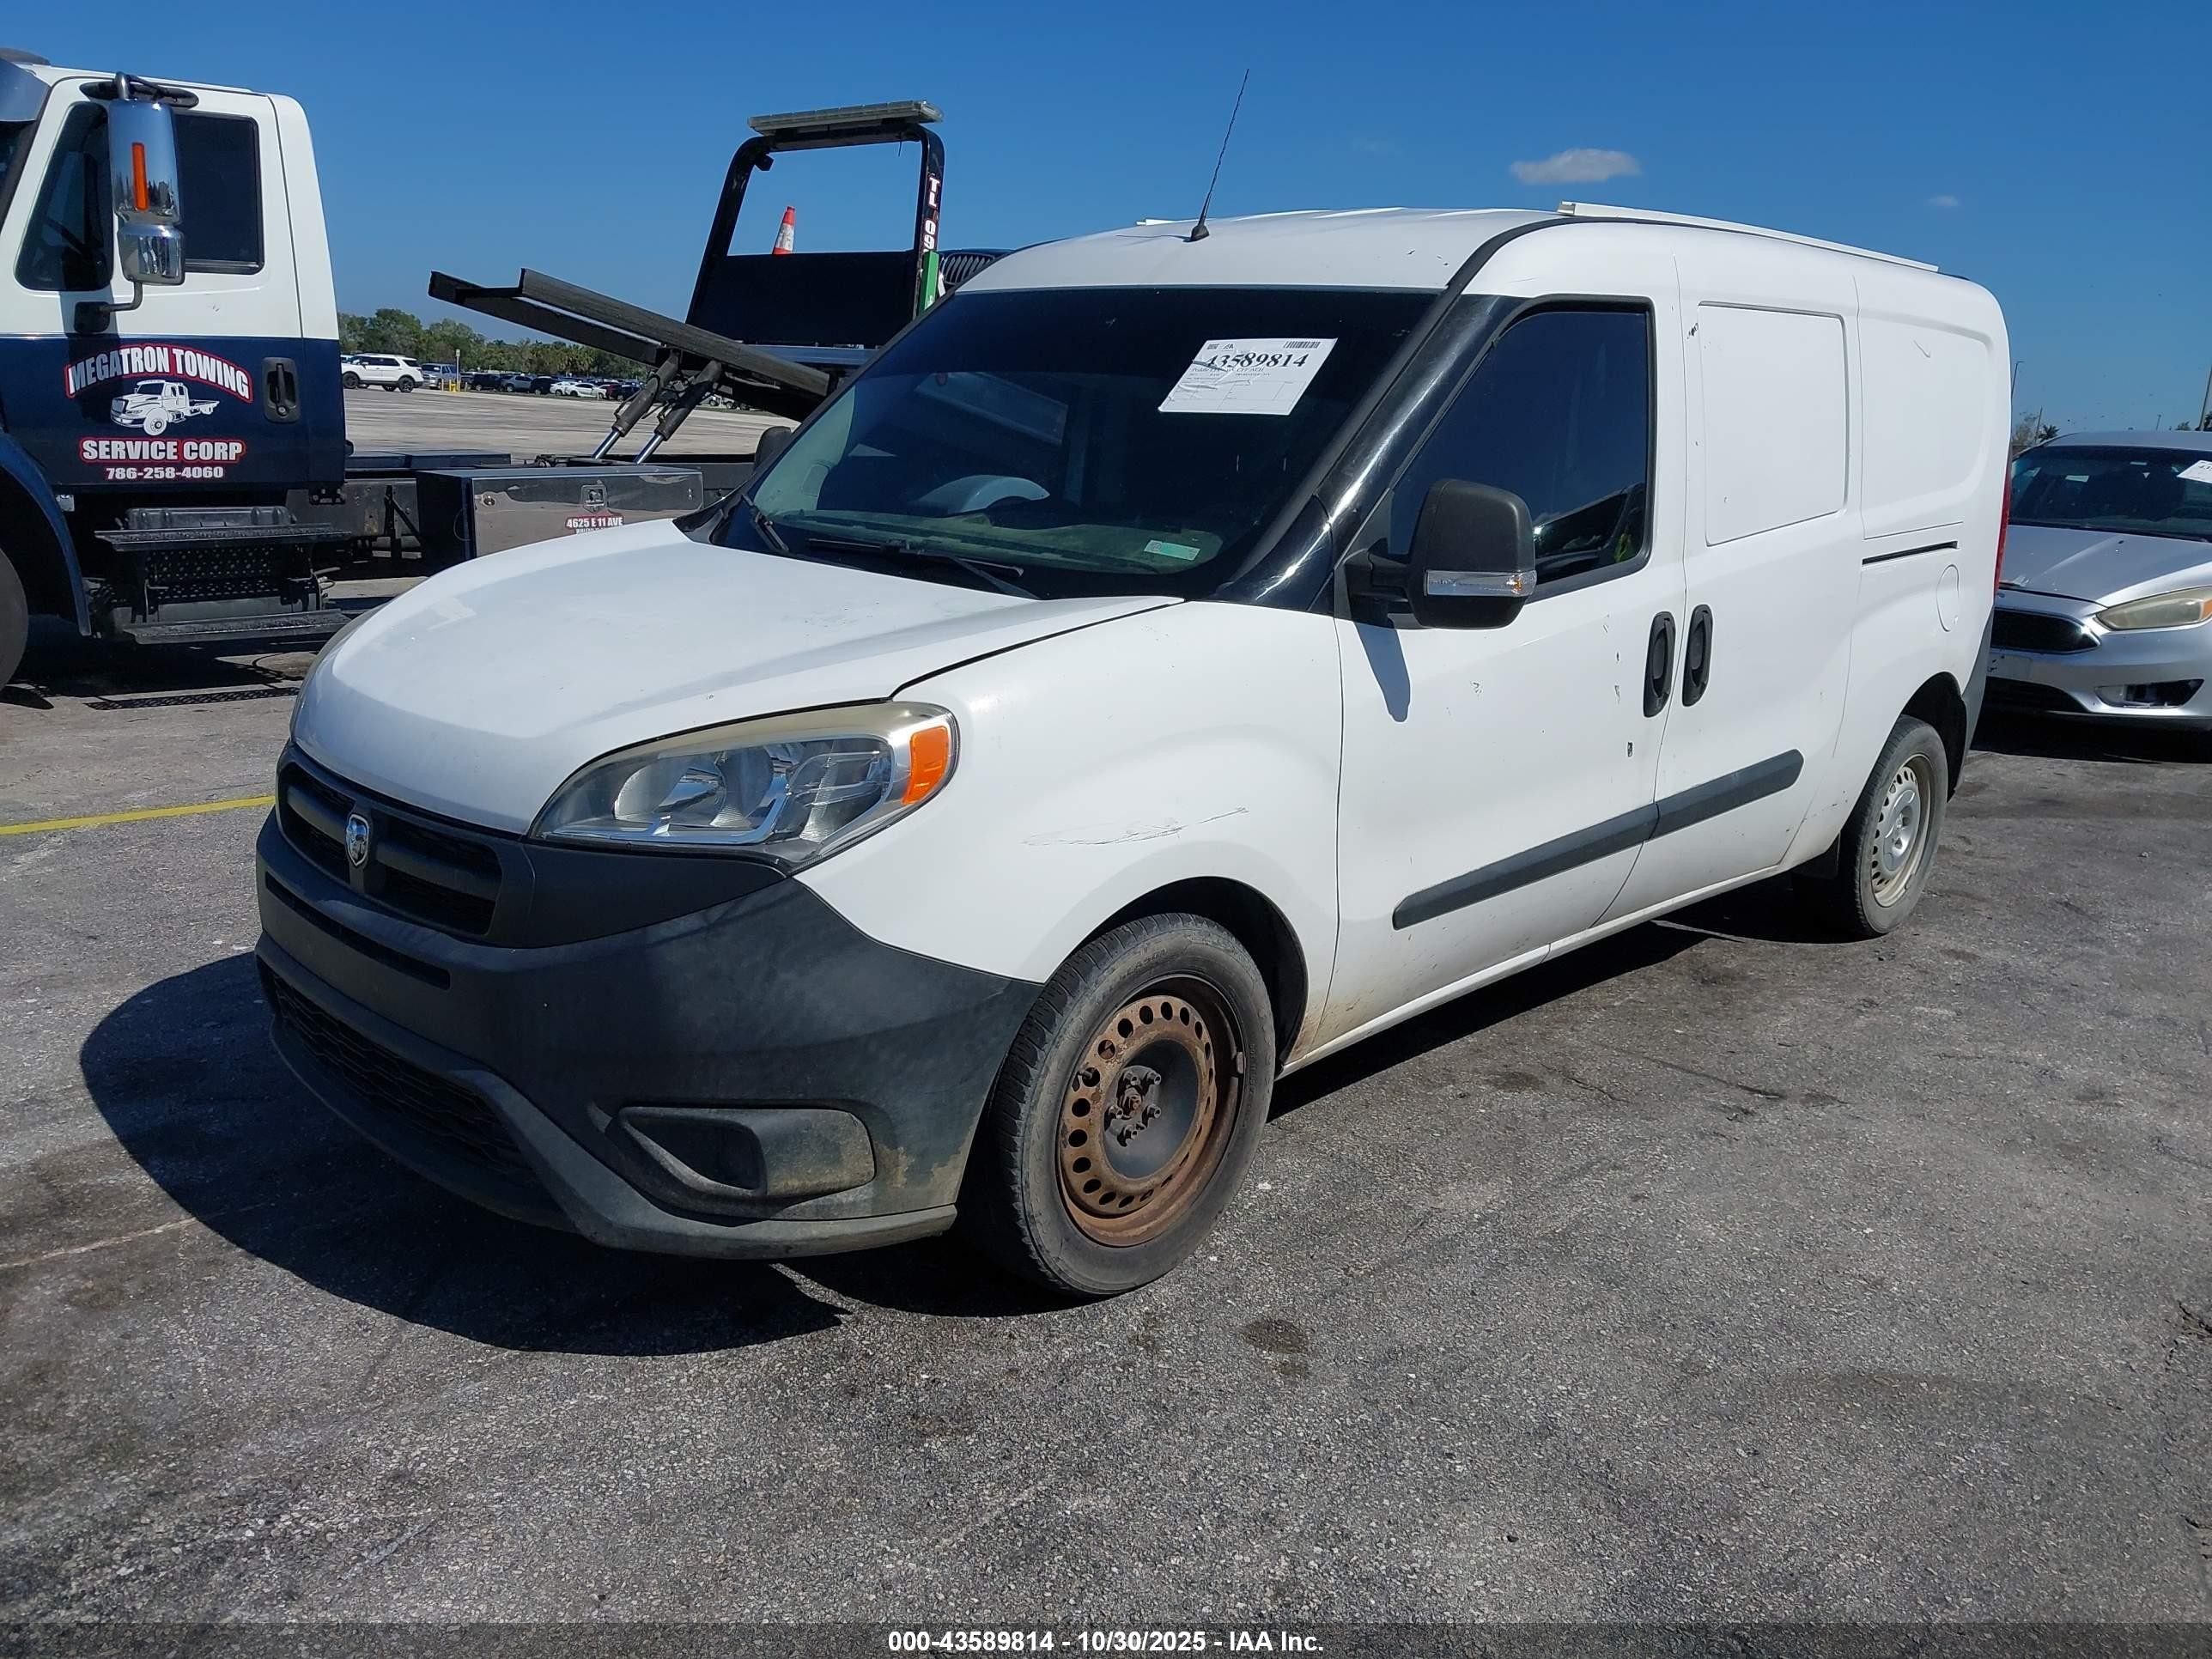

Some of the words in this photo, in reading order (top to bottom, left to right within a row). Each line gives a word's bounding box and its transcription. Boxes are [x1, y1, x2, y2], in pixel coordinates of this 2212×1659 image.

[68, 346, 169, 394] MEGATRON
[173, 348, 249, 399] TOWING
[82, 440, 178, 461] SERVICE
[183, 441, 242, 461] CORP
[106, 466, 224, 480] 786-258-4060
[567, 518, 590, 528] 4625
[591, 517, 597, 527] E
[597, 517, 606, 527] 11
[607, 516, 623, 526] AVE
